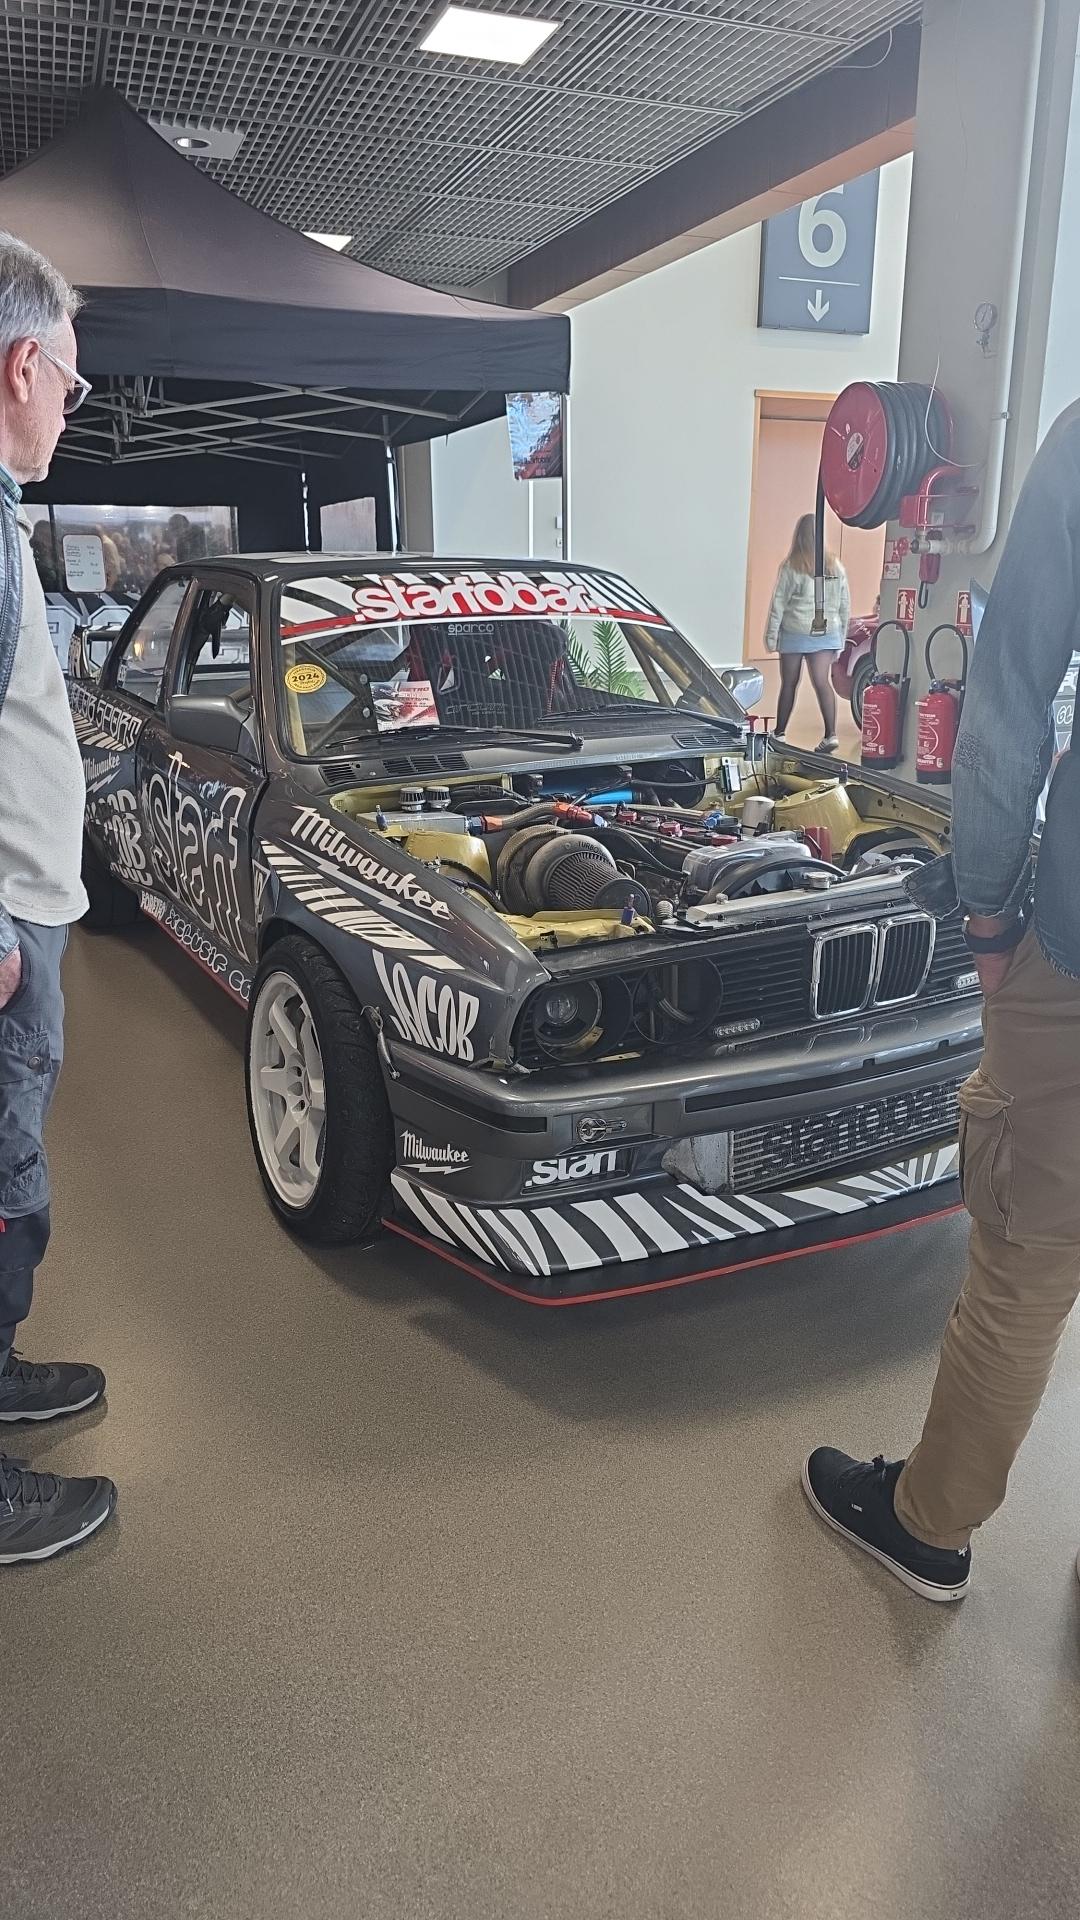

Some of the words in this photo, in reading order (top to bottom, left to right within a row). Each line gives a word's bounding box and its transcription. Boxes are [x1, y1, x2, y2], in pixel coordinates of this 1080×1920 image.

[798, 184, 847, 268] 6
[448, 623, 494, 637] sparco
[291, 672, 320, 683] 2024
[96, 699, 143, 748] SPORT
[290, 805, 455, 920] Milwaukee
[399, 1129, 470, 1163] Milwaukee
